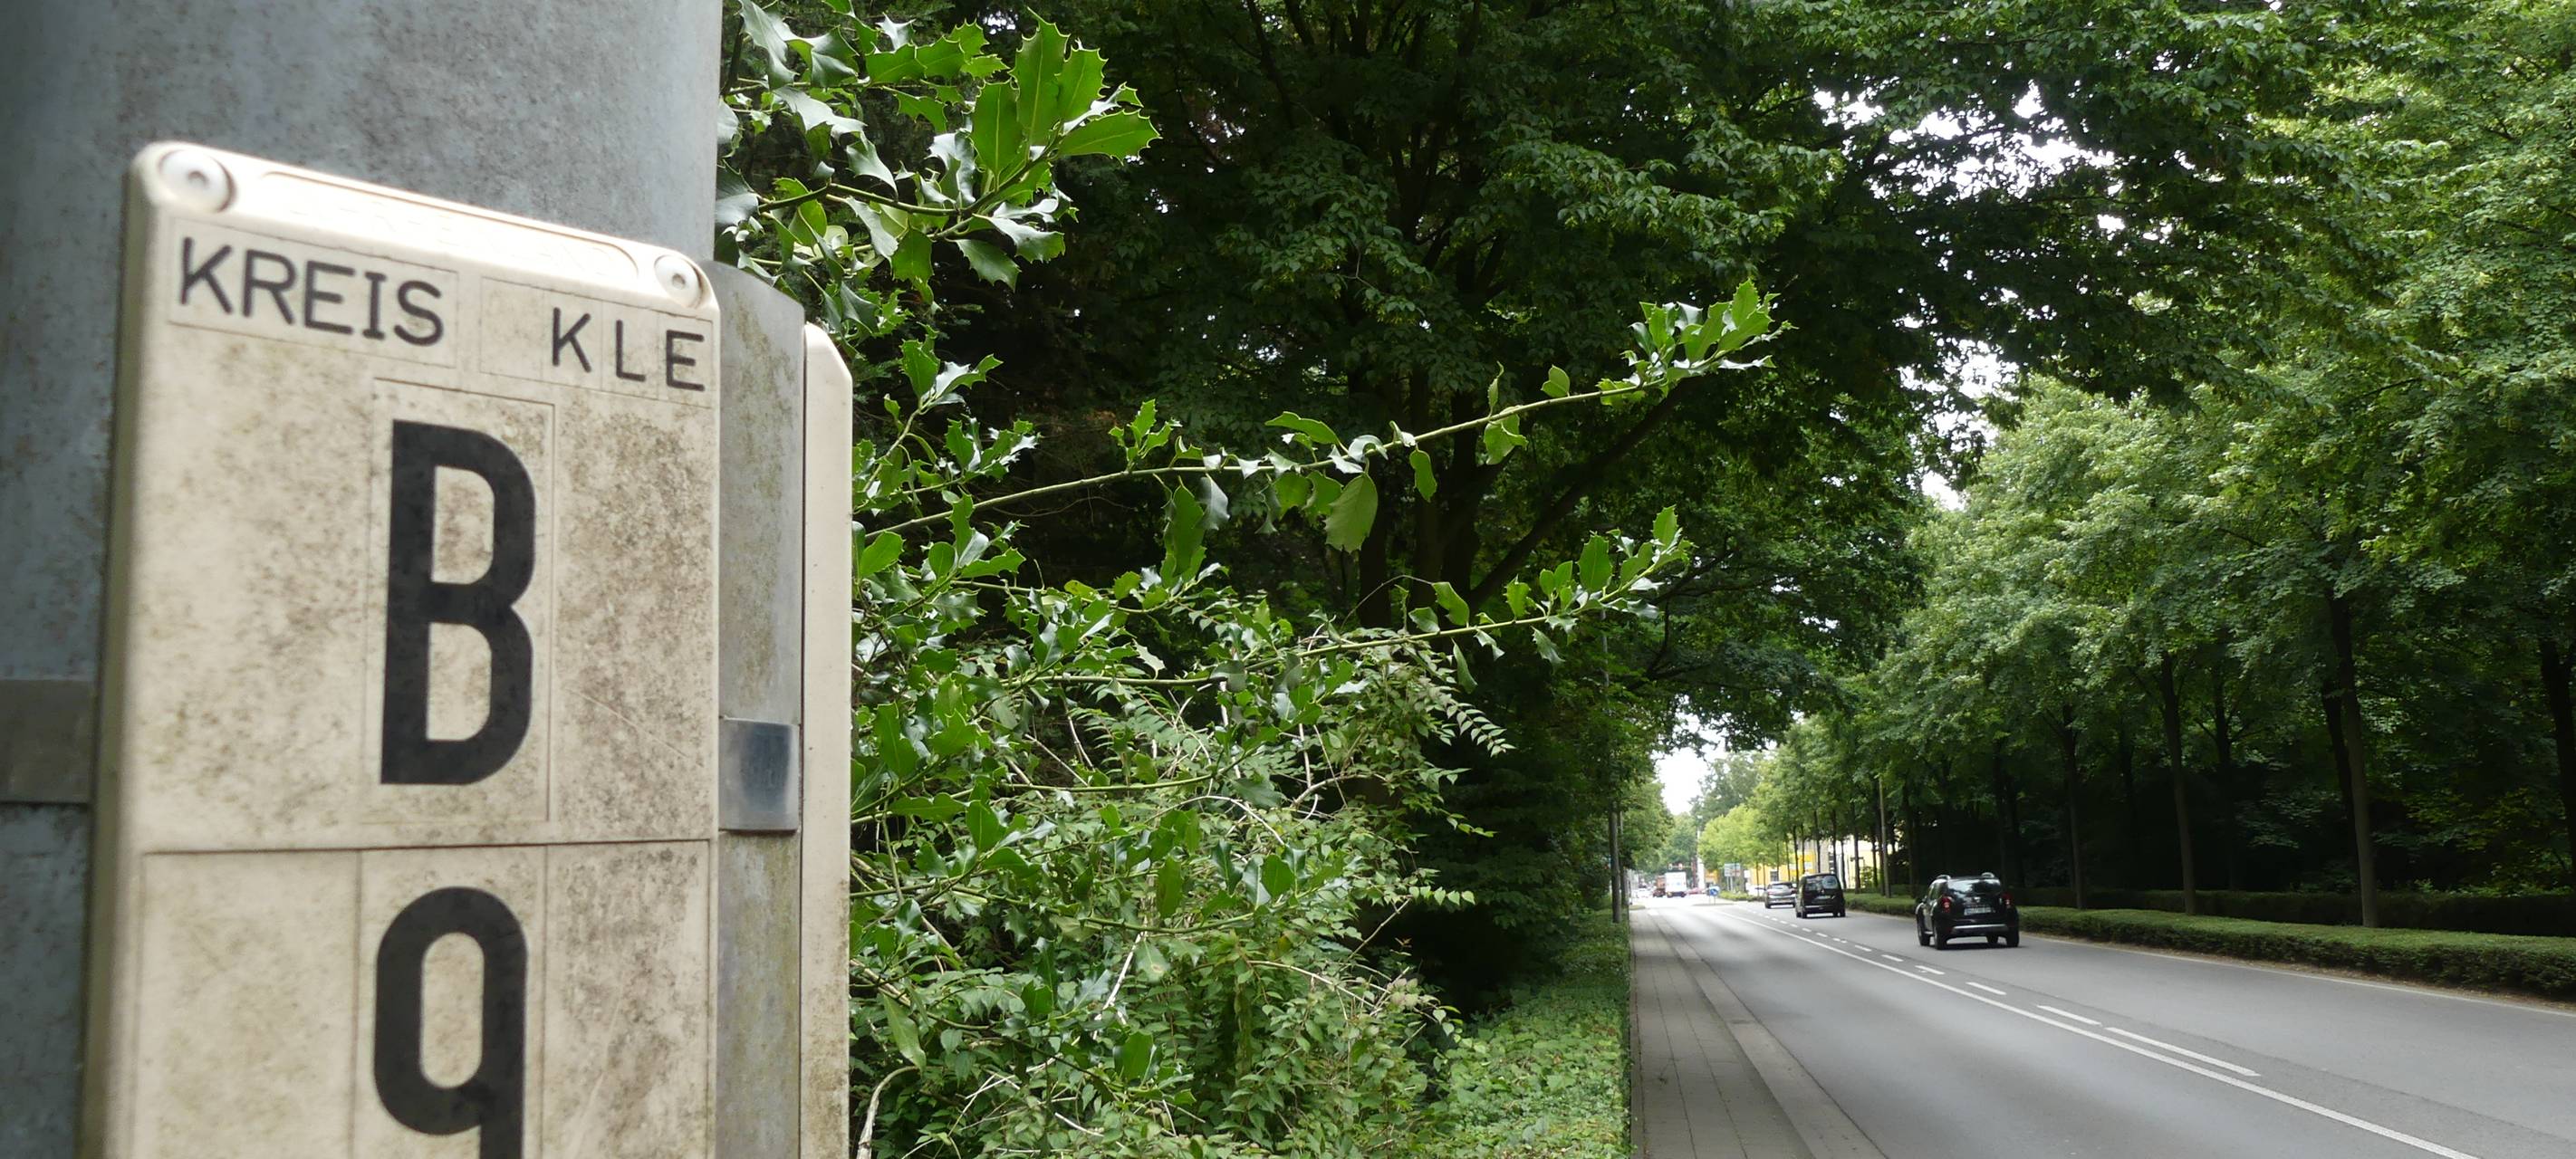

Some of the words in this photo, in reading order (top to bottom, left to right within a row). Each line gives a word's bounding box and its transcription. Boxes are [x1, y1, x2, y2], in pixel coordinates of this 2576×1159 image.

[180, 236, 444, 348] KREIS
[550, 307, 706, 392] KLE
[380, 418, 536, 787] B
[372, 886, 528, 1159] 9
